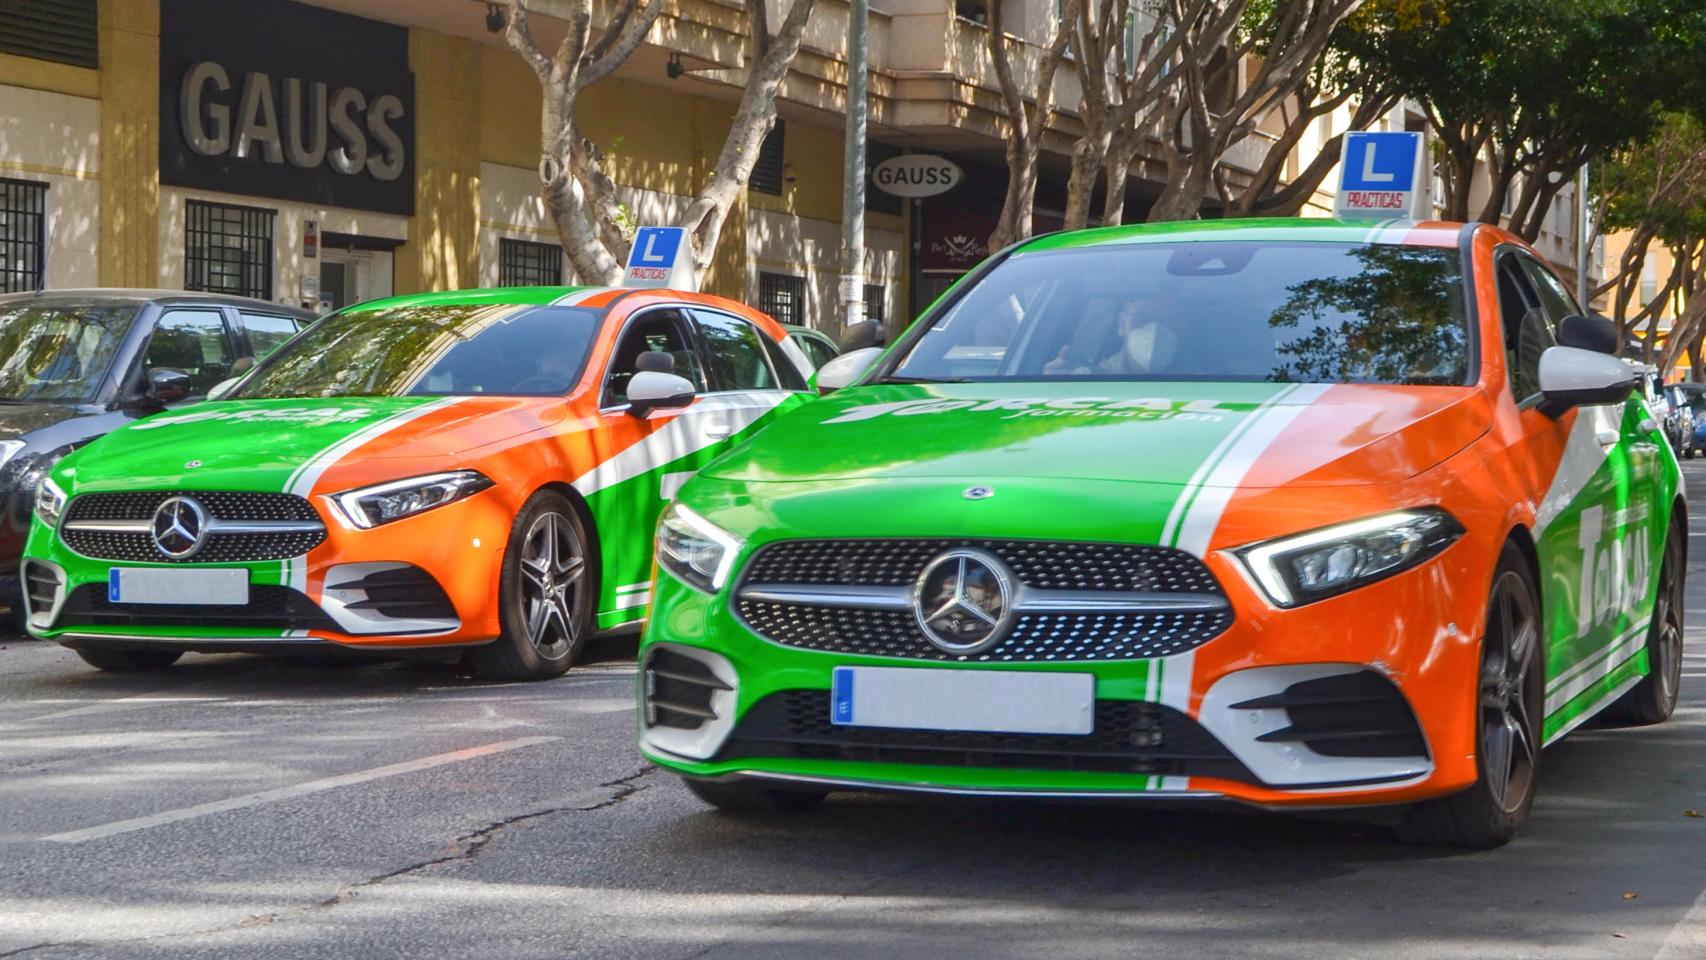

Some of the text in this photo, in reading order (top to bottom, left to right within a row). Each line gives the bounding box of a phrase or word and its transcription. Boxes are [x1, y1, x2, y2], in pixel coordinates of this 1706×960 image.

[179, 61, 405, 181] GAUSS
[1362, 142, 1394, 182] L
[878, 167, 952, 185] GAUSS
[1347, 192, 1404, 208] PRACTICAS
[642, 234, 664, 262] L
[631, 268, 667, 280] PRACTICAS
